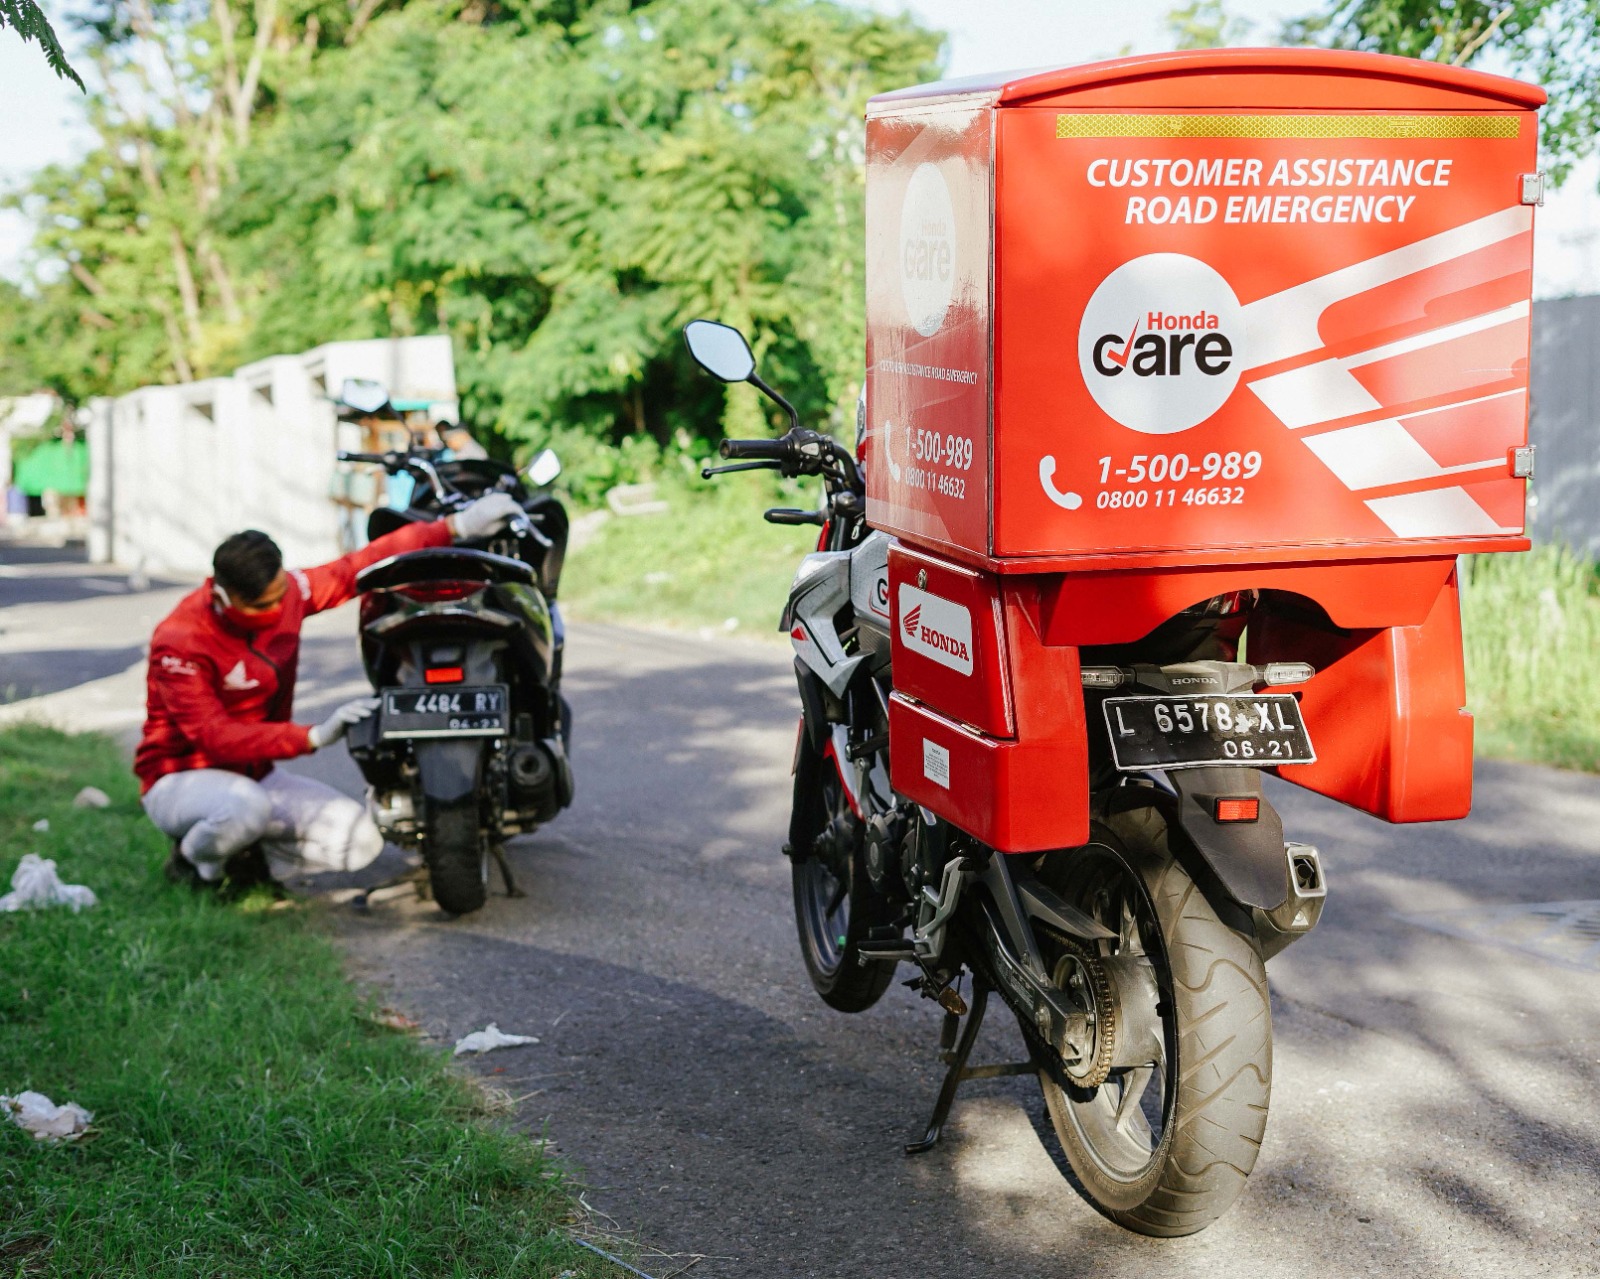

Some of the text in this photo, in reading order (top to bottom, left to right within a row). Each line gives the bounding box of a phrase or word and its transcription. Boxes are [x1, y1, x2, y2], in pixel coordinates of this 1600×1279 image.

[1087, 158, 1453, 187] CUSTOMER ASSISTANCE
[1124, 195, 1416, 224] ROAD EMERGENCY
[1147, 310, 1219, 331] Honda
[1092, 332, 1233, 377] care
[931, 366, 946, 380] ROAD
[946, 368, 978, 385] EMERGENCY
[905, 426, 973, 471] 1-500-989
[1098, 450, 1262, 484] 1-500-989
[905, 466, 965, 499] 0800 11 46632
[1096, 486, 1245, 509] 0800 11 46632
[921, 625, 970, 662] HONDA
[1172, 677, 1219, 685] HONDA
[388, 695, 400, 715] L
[474, 692, 499, 712] RY
[1116, 702, 1295, 736] L 6578 XL
